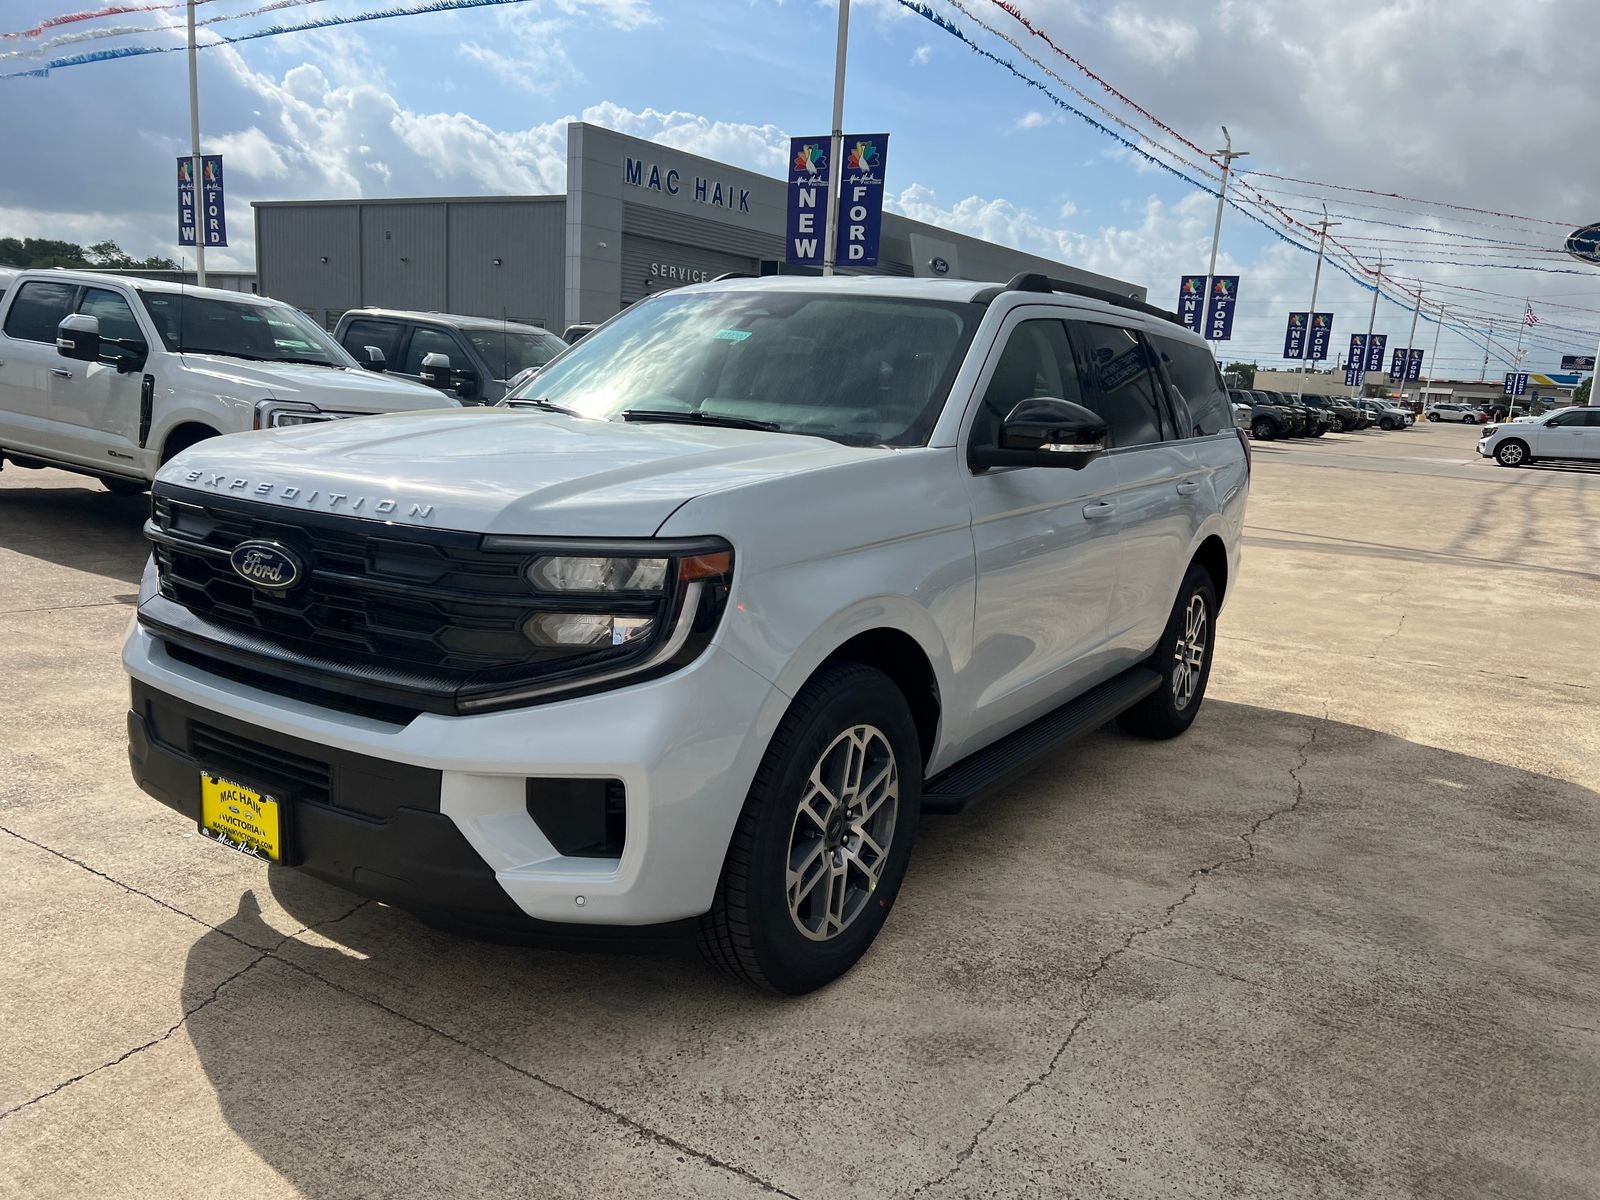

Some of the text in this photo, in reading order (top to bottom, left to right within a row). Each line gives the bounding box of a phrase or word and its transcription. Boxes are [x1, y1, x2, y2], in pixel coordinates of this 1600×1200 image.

[625, 157, 751, 213] MAC HAIK
[181, 191, 195, 241] NEW
[208, 192, 220, 243] FORD
[794, 188, 818, 258] NEW
[848, 186, 868, 260] FORD
[651, 263, 708, 282] SERVICE
[1212, 301, 1227, 338] FORD
[1288, 330, 1300, 357] NEW
[1312, 331, 1324, 358] FORD
[1350, 348, 1361, 369] NEW
[1370, 348, 1380, 370] FORD
[1392, 360, 1402, 378] NEW
[1408, 361, 1418, 379] FORD
[185, 470, 434, 519] EXPEDITION
[241, 549, 284, 583] Ford
[220, 790, 238, 803] MAC
[239, 791, 262, 818] HAIK
[224, 815, 260, 836] VICTORIA
[216, 832, 262, 859] Mac Haik
